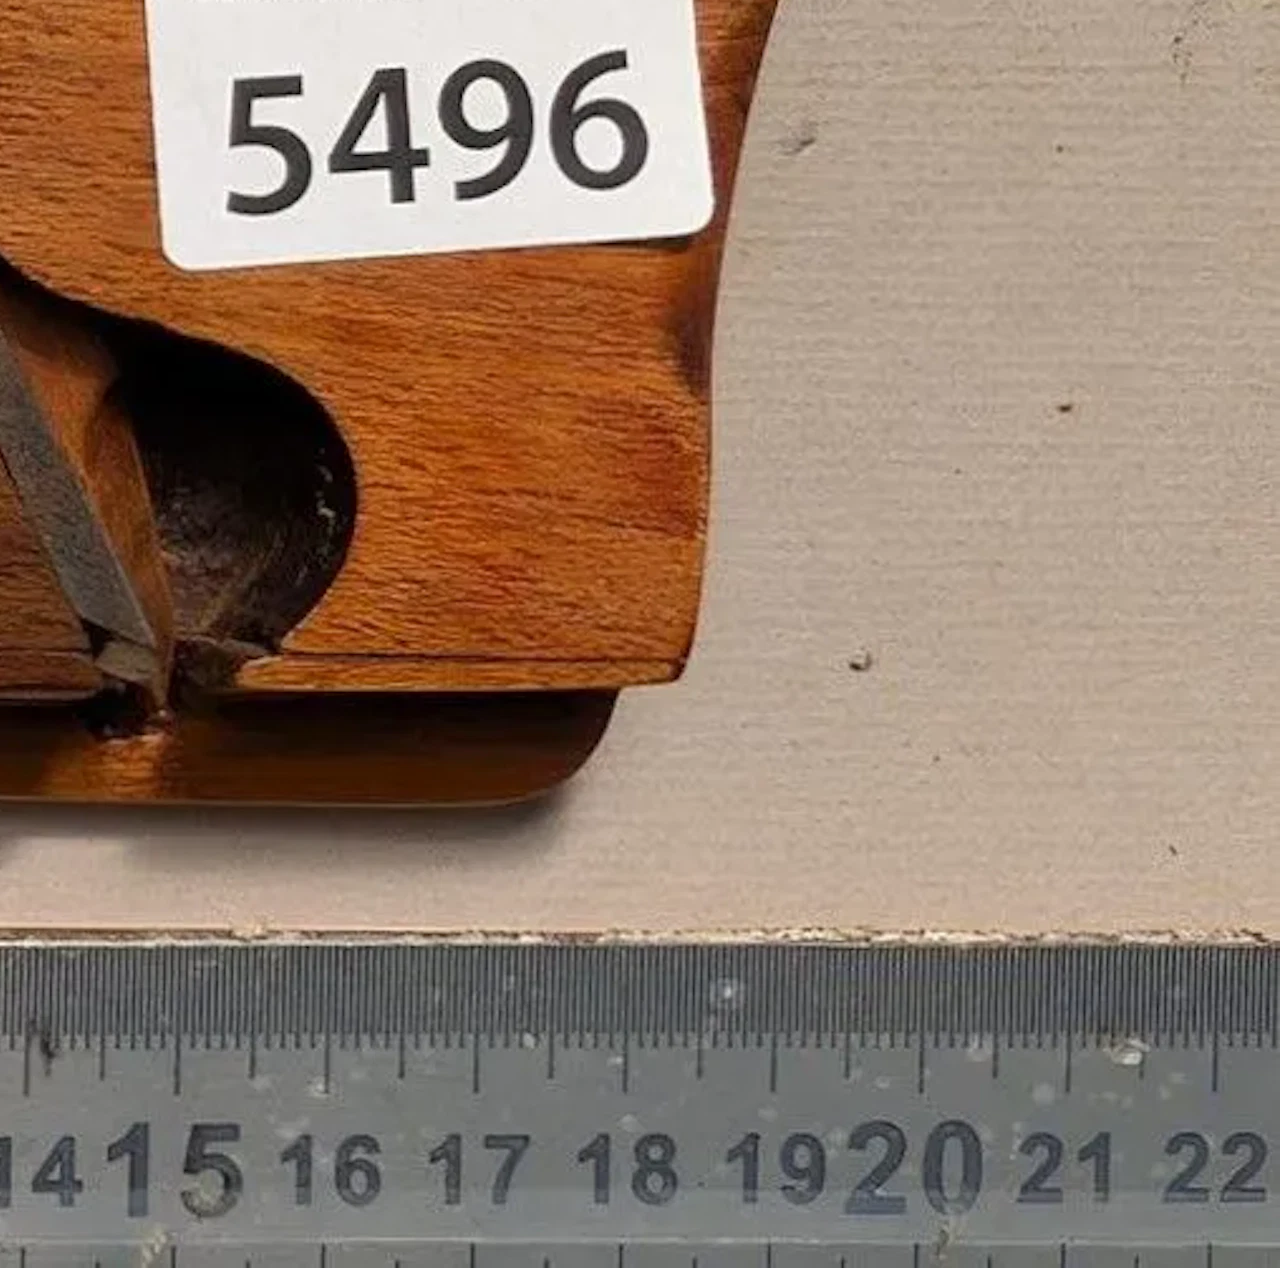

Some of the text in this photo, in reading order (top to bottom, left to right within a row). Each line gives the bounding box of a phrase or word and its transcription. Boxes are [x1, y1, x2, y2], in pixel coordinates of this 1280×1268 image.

[225, 49, 650, 217] 5496
[106, 1122, 243, 1219] 15
[280, 1134, 382, 1207] 16
[429, 1134, 531, 1206] 17
[577, 1133, 678, 1206] 18
[726, 1132, 827, 1206] 19
[844, 1119, 983, 1216] 20
[1016, 1132, 1111, 1204] 21
[1163, 1132, 1267, 1204] 22
